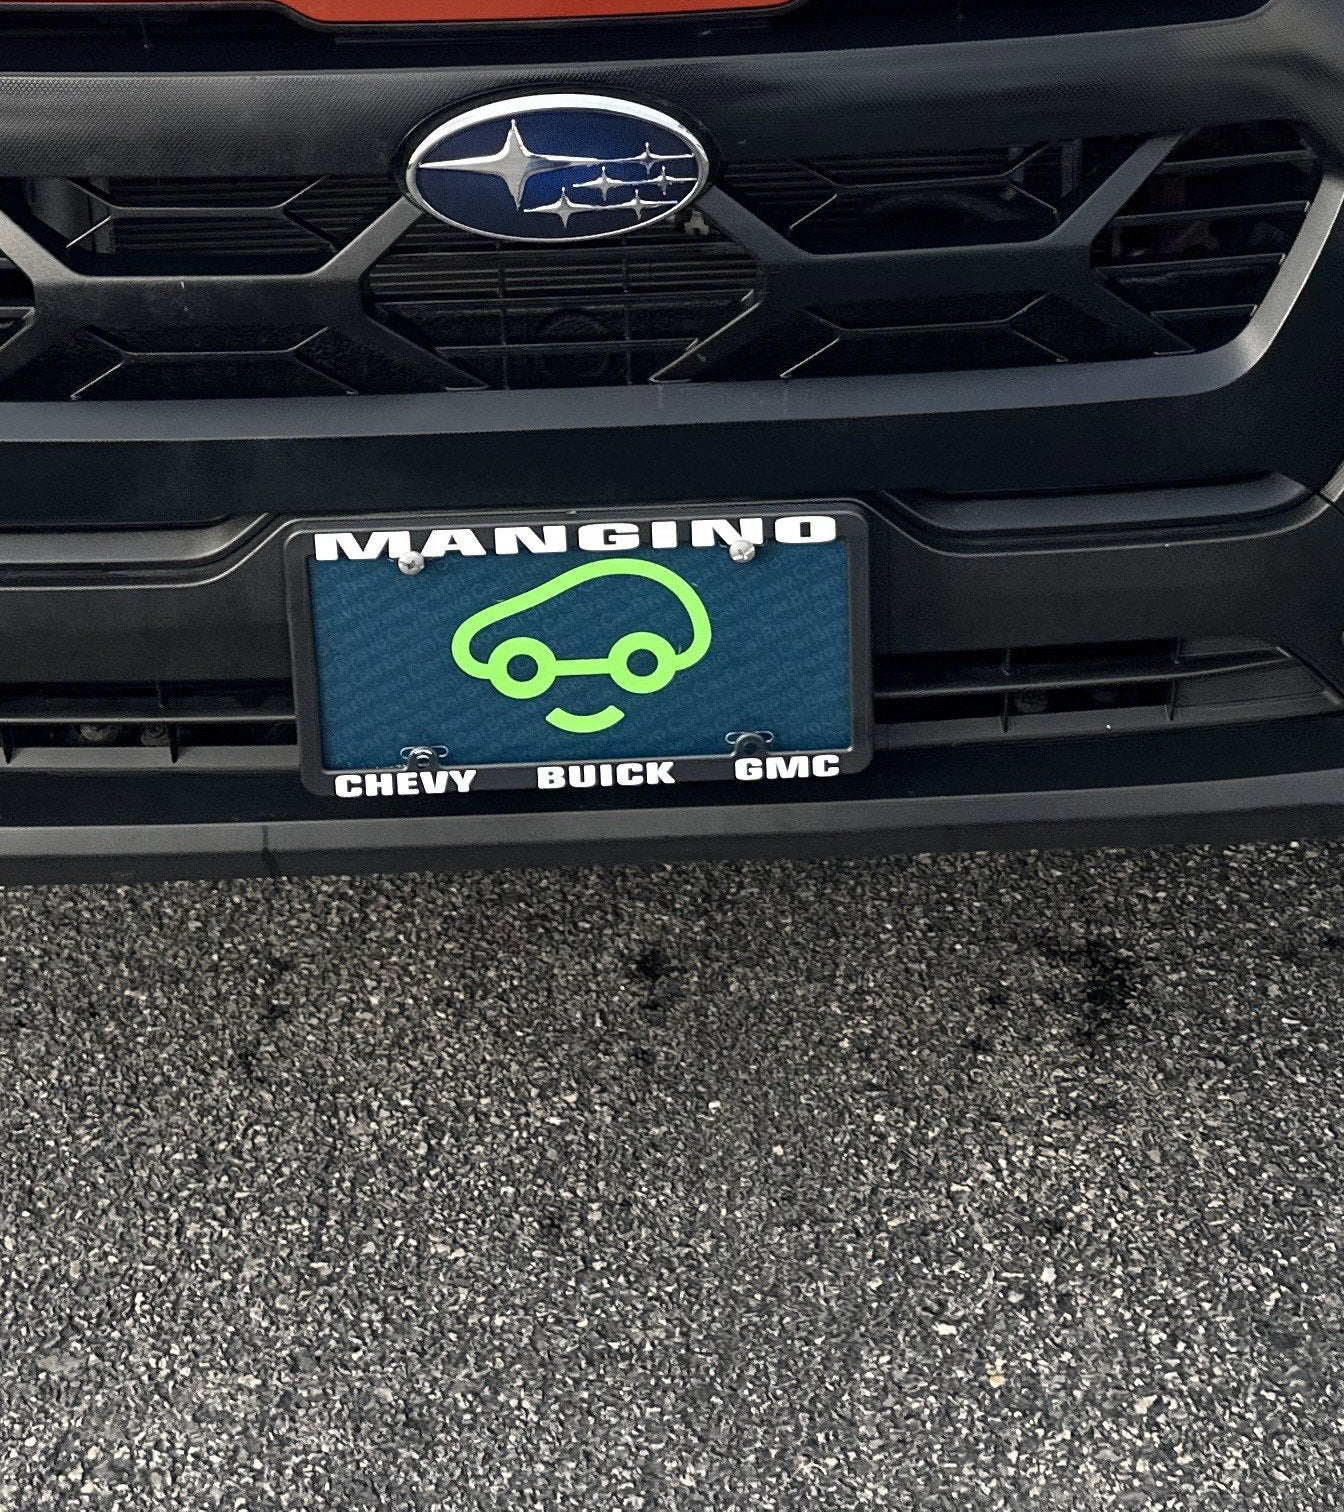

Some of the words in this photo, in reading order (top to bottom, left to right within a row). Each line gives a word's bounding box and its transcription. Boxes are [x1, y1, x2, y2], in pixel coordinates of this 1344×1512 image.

[313, 514, 838, 562] MANGINO
[334, 769, 478, 799] CHEVY
[536, 761, 676, 790] BUICK
[734, 753, 841, 782] GMC
